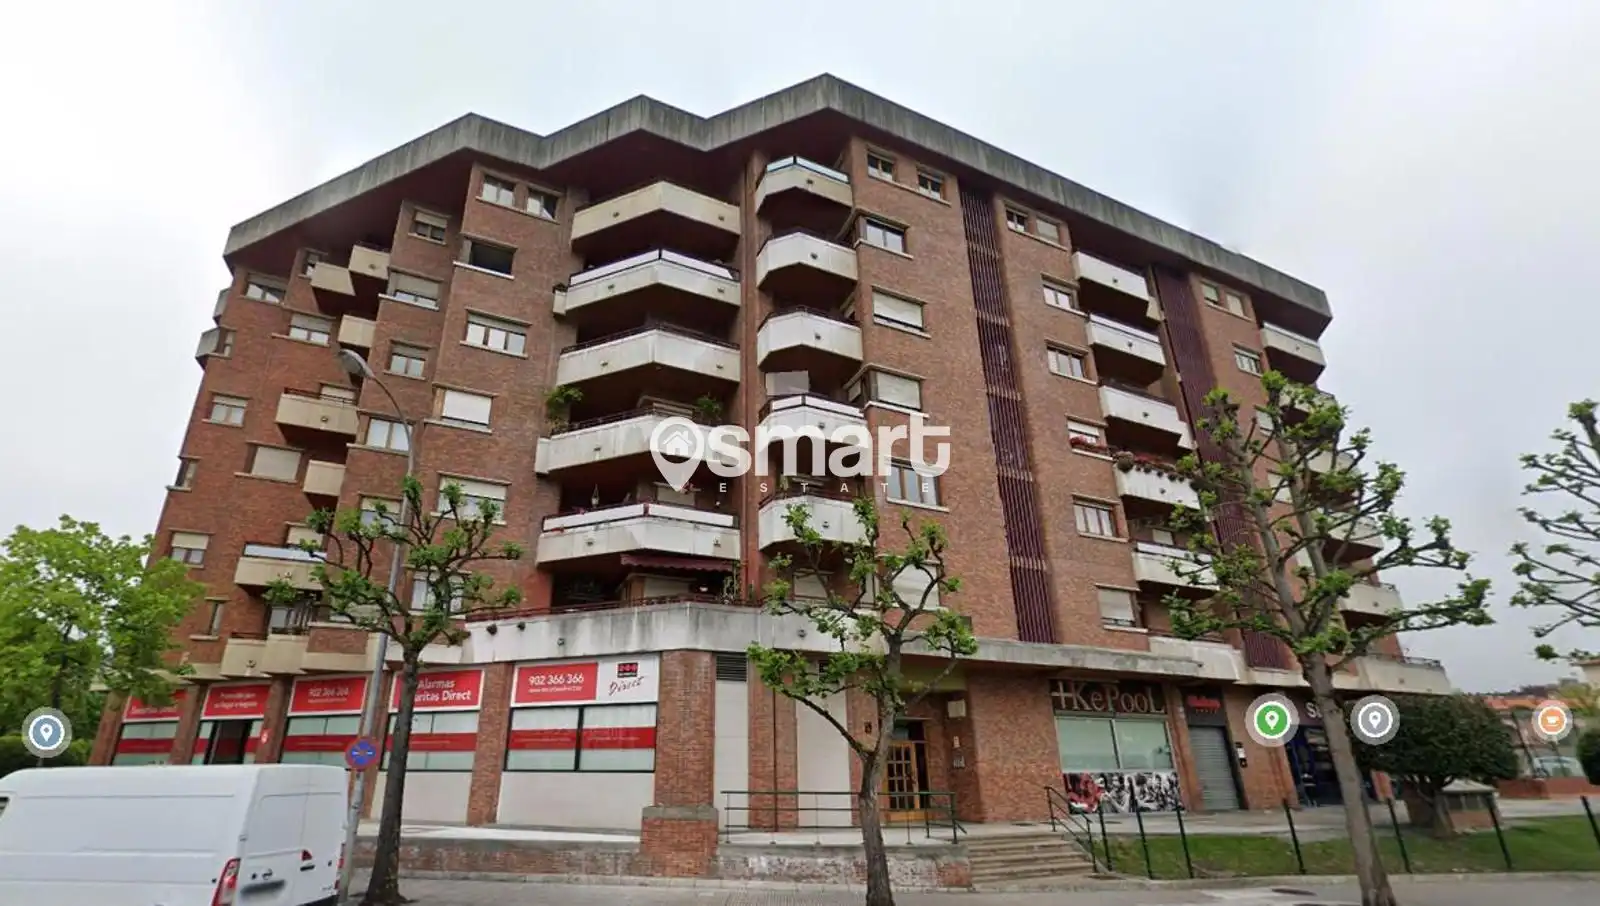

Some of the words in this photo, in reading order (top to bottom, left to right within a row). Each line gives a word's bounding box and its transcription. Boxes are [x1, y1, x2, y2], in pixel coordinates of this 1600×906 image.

[417, 677, 456, 690] Alarmas
[528, 675, 546, 686] 902
[547, 673, 565, 685] 366
[566, 672, 584, 684] 366
[441, 689, 472, 701] Direct
